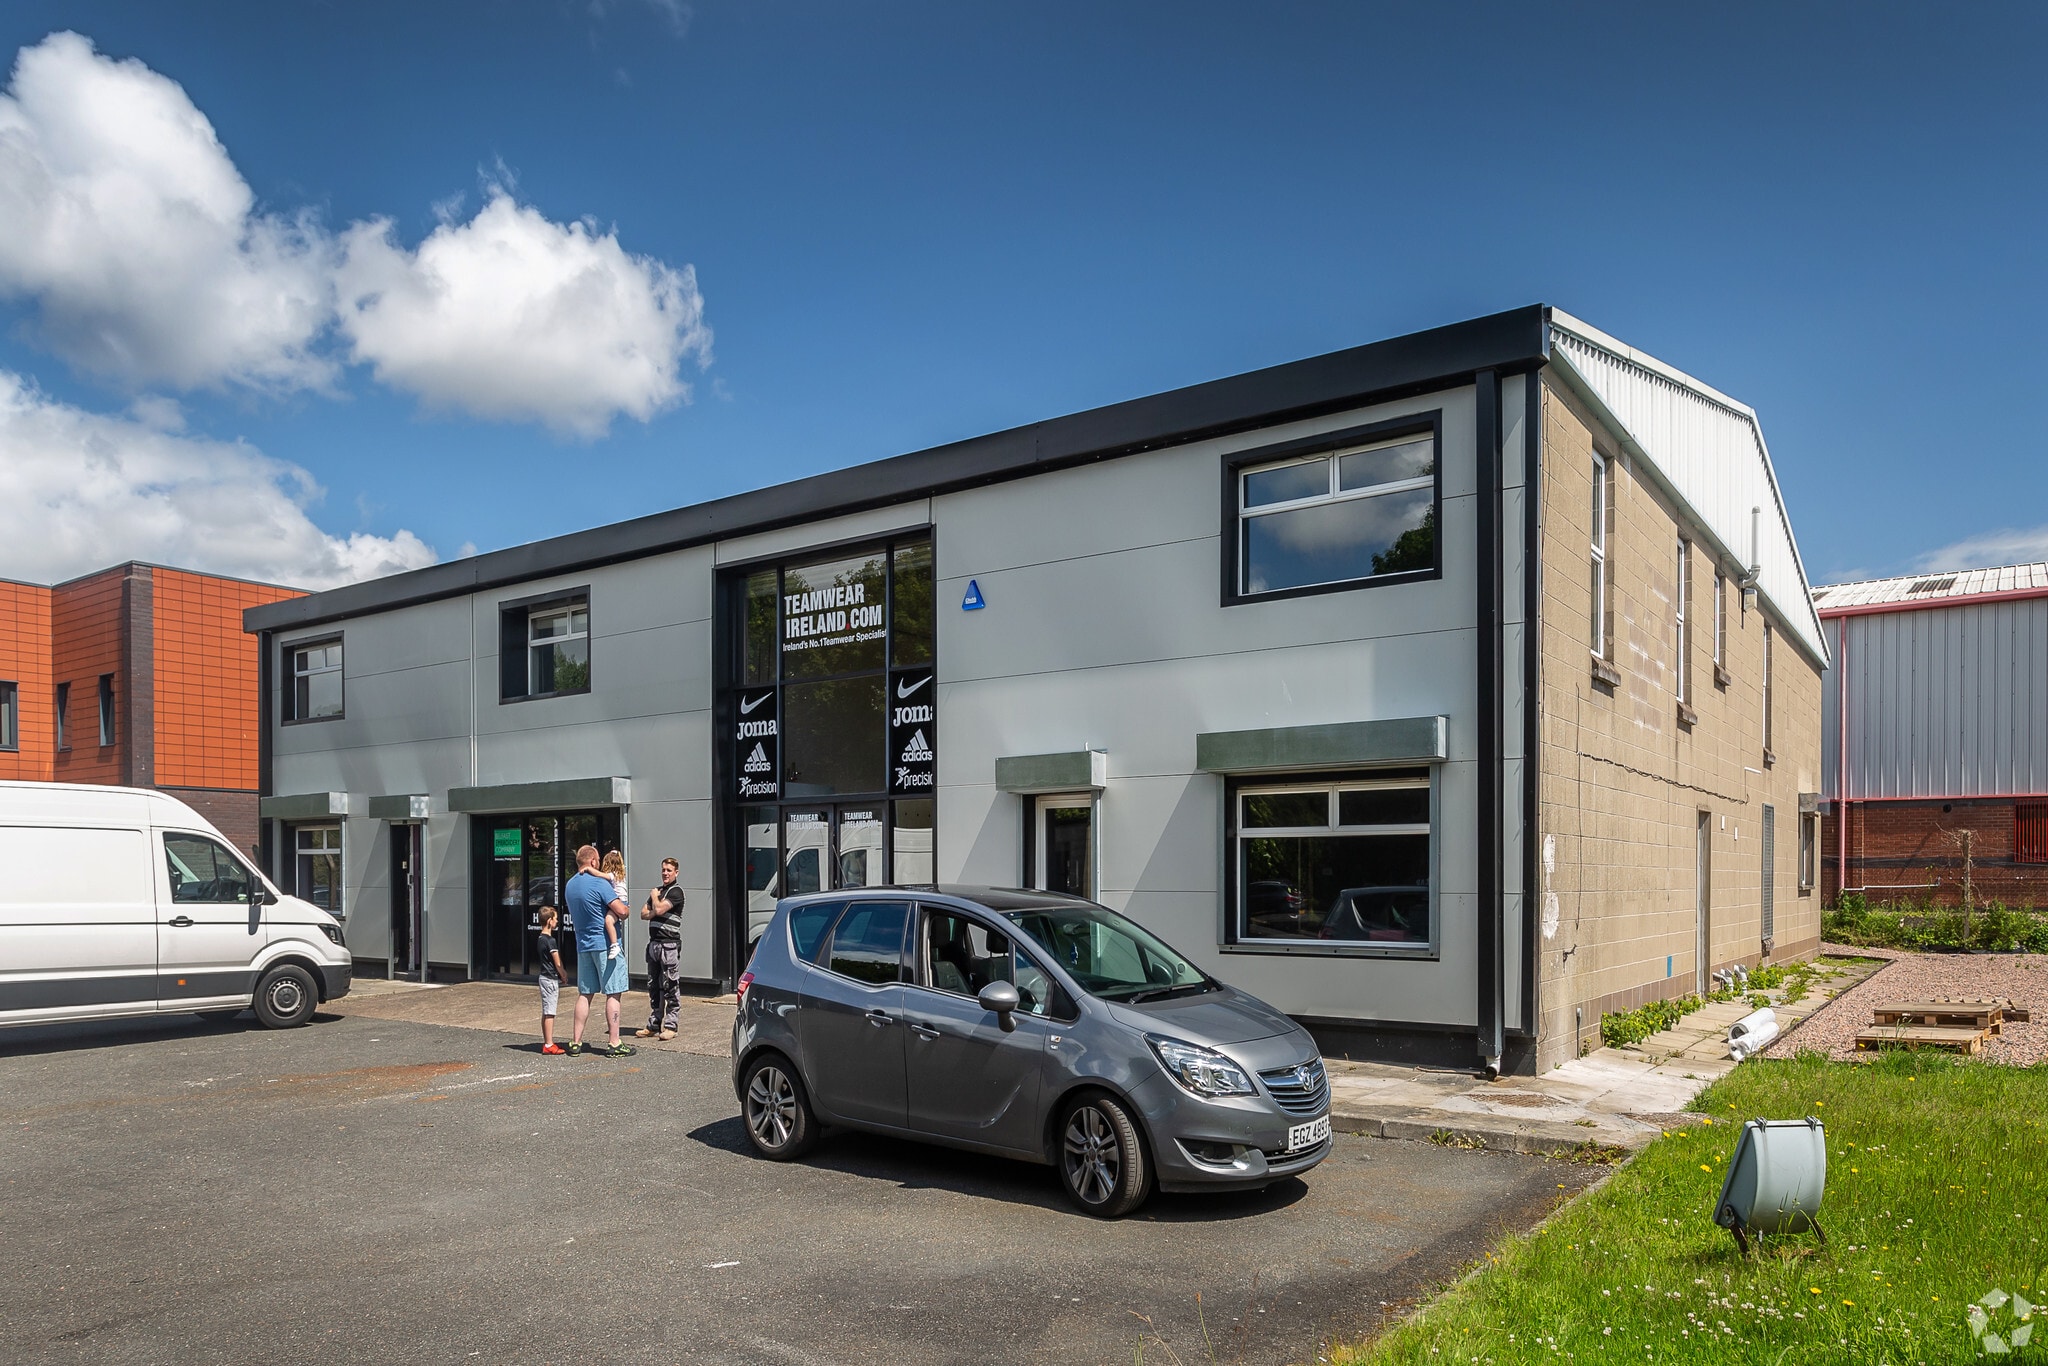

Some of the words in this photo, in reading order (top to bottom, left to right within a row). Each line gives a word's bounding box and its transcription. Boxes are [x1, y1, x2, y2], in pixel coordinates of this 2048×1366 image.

[784, 583, 865, 615] TEAMWEAR
[786, 604, 882, 639] IRELAND.COM
[783, 640, 808, 652] Ireland's
[893, 705, 932, 727] Jom
[901, 749, 933, 762] adidas
[744, 760, 771, 772] adidas
[746, 780, 777, 797] precision
[903, 771, 933, 790] precisi
[790, 814, 819, 822] TEAMWEAR
[844, 811, 873, 820] TEAMWEAR
[1293, 1126, 1310, 1146] EGZ
